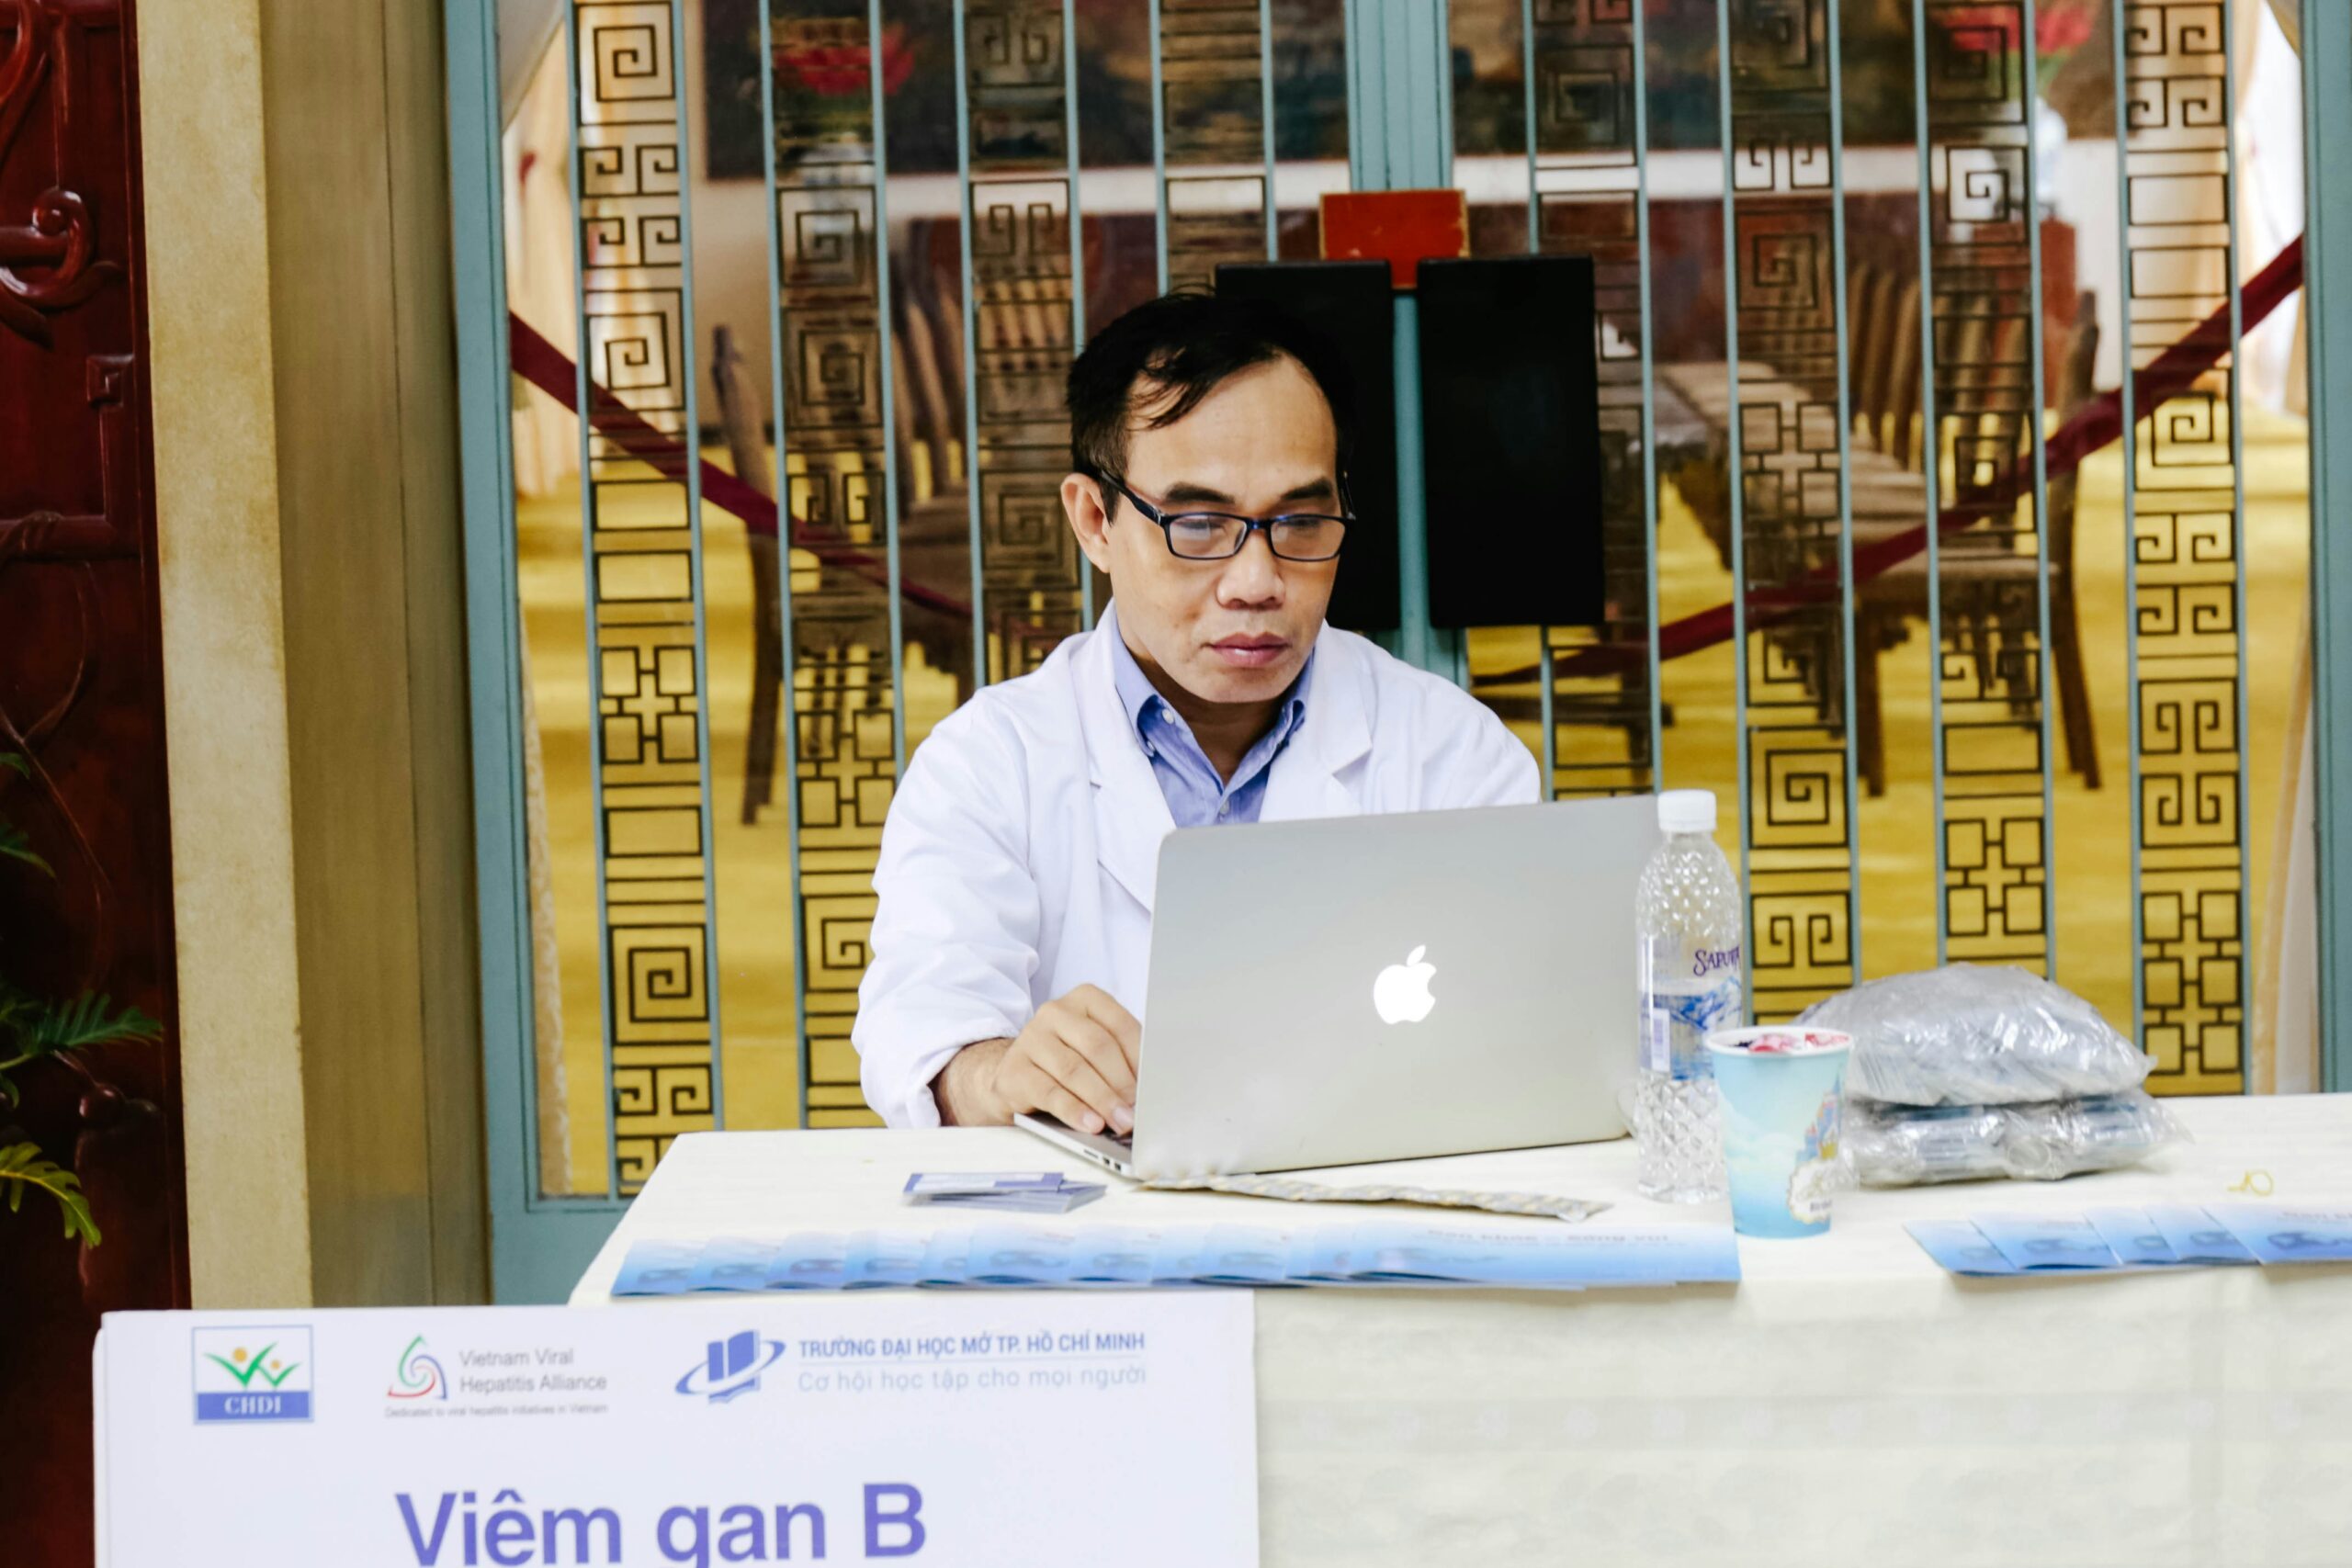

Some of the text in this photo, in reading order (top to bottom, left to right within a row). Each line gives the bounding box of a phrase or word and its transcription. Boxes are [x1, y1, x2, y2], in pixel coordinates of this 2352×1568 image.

[798, 1327, 1145, 1360] TRƯỜNG ĐẠI HỌC MỞ TP. HỒ CHÍ MINH
[458, 1348, 574, 1367] Vietnam Viral
[459, 1374, 607, 1395] Hepatitis Alliance
[798, 1364, 1146, 1393] Cơ hội học tập cho mọi người
[224, 1395, 281, 1415] CHDI
[394, 1483, 927, 1568] Viêm gan B
